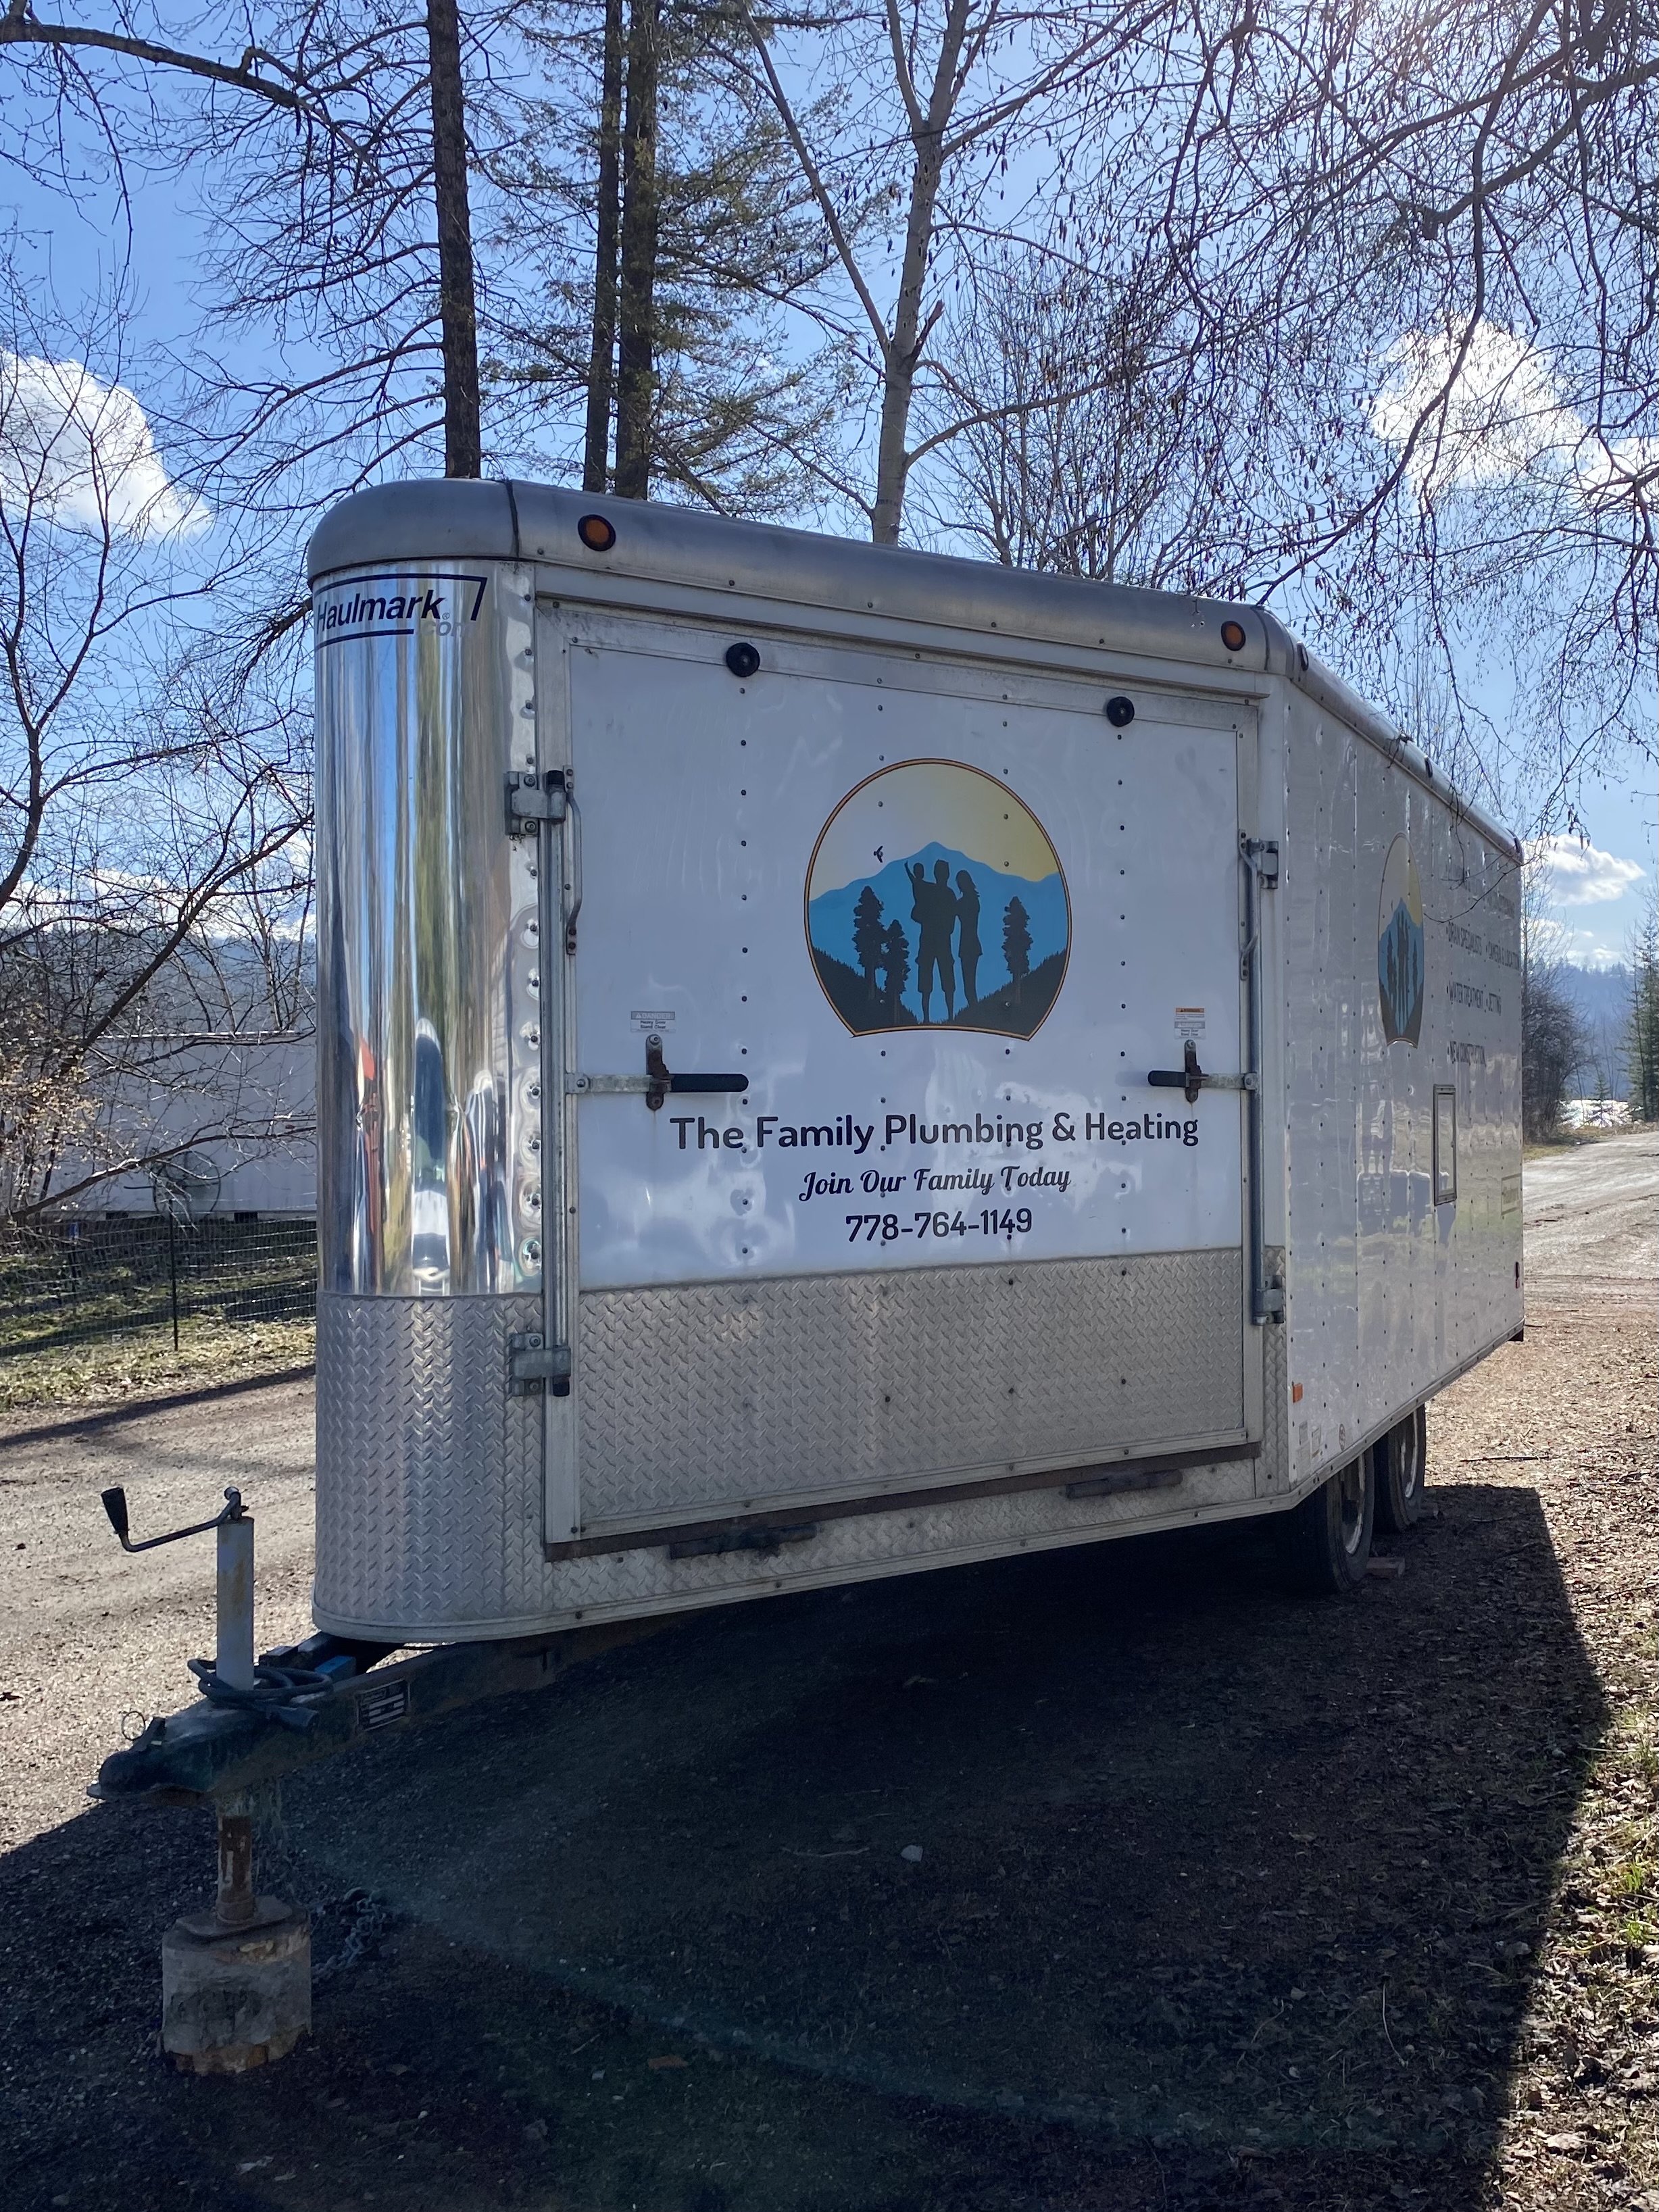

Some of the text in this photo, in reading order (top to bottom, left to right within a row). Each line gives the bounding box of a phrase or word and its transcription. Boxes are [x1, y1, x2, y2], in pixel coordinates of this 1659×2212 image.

[316, 589, 446, 634] Haulmark
[670, 1112, 1199, 1155] The Family Plumbing & Heating
[798, 1165, 1072, 1202] Join Our Family Today
[845, 1208, 1033, 1242] 778-764-1149
